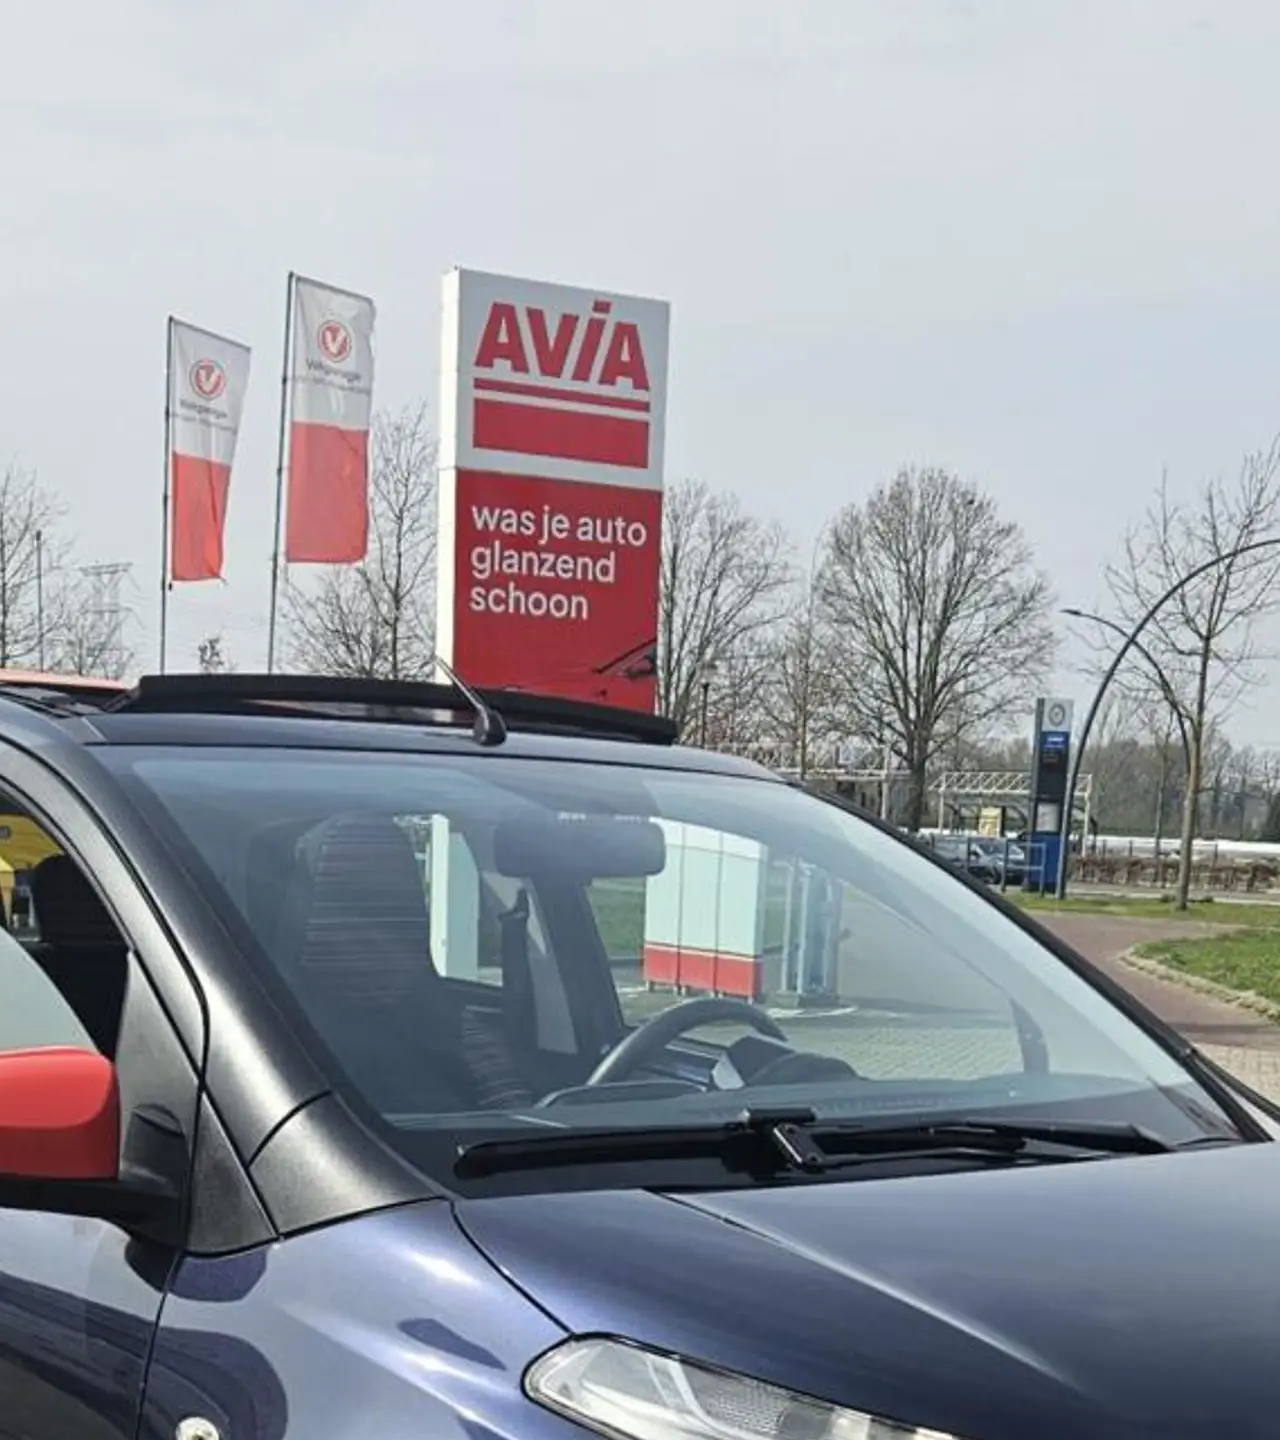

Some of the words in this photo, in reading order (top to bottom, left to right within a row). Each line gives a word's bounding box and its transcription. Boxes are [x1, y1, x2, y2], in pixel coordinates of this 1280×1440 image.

[472, 505, 536, 535] was
[538, 505, 570, 545] je
[577, 515, 647, 546] auto
[471, 540, 616, 583] glanzend
[470, 580, 588, 620] schoon
